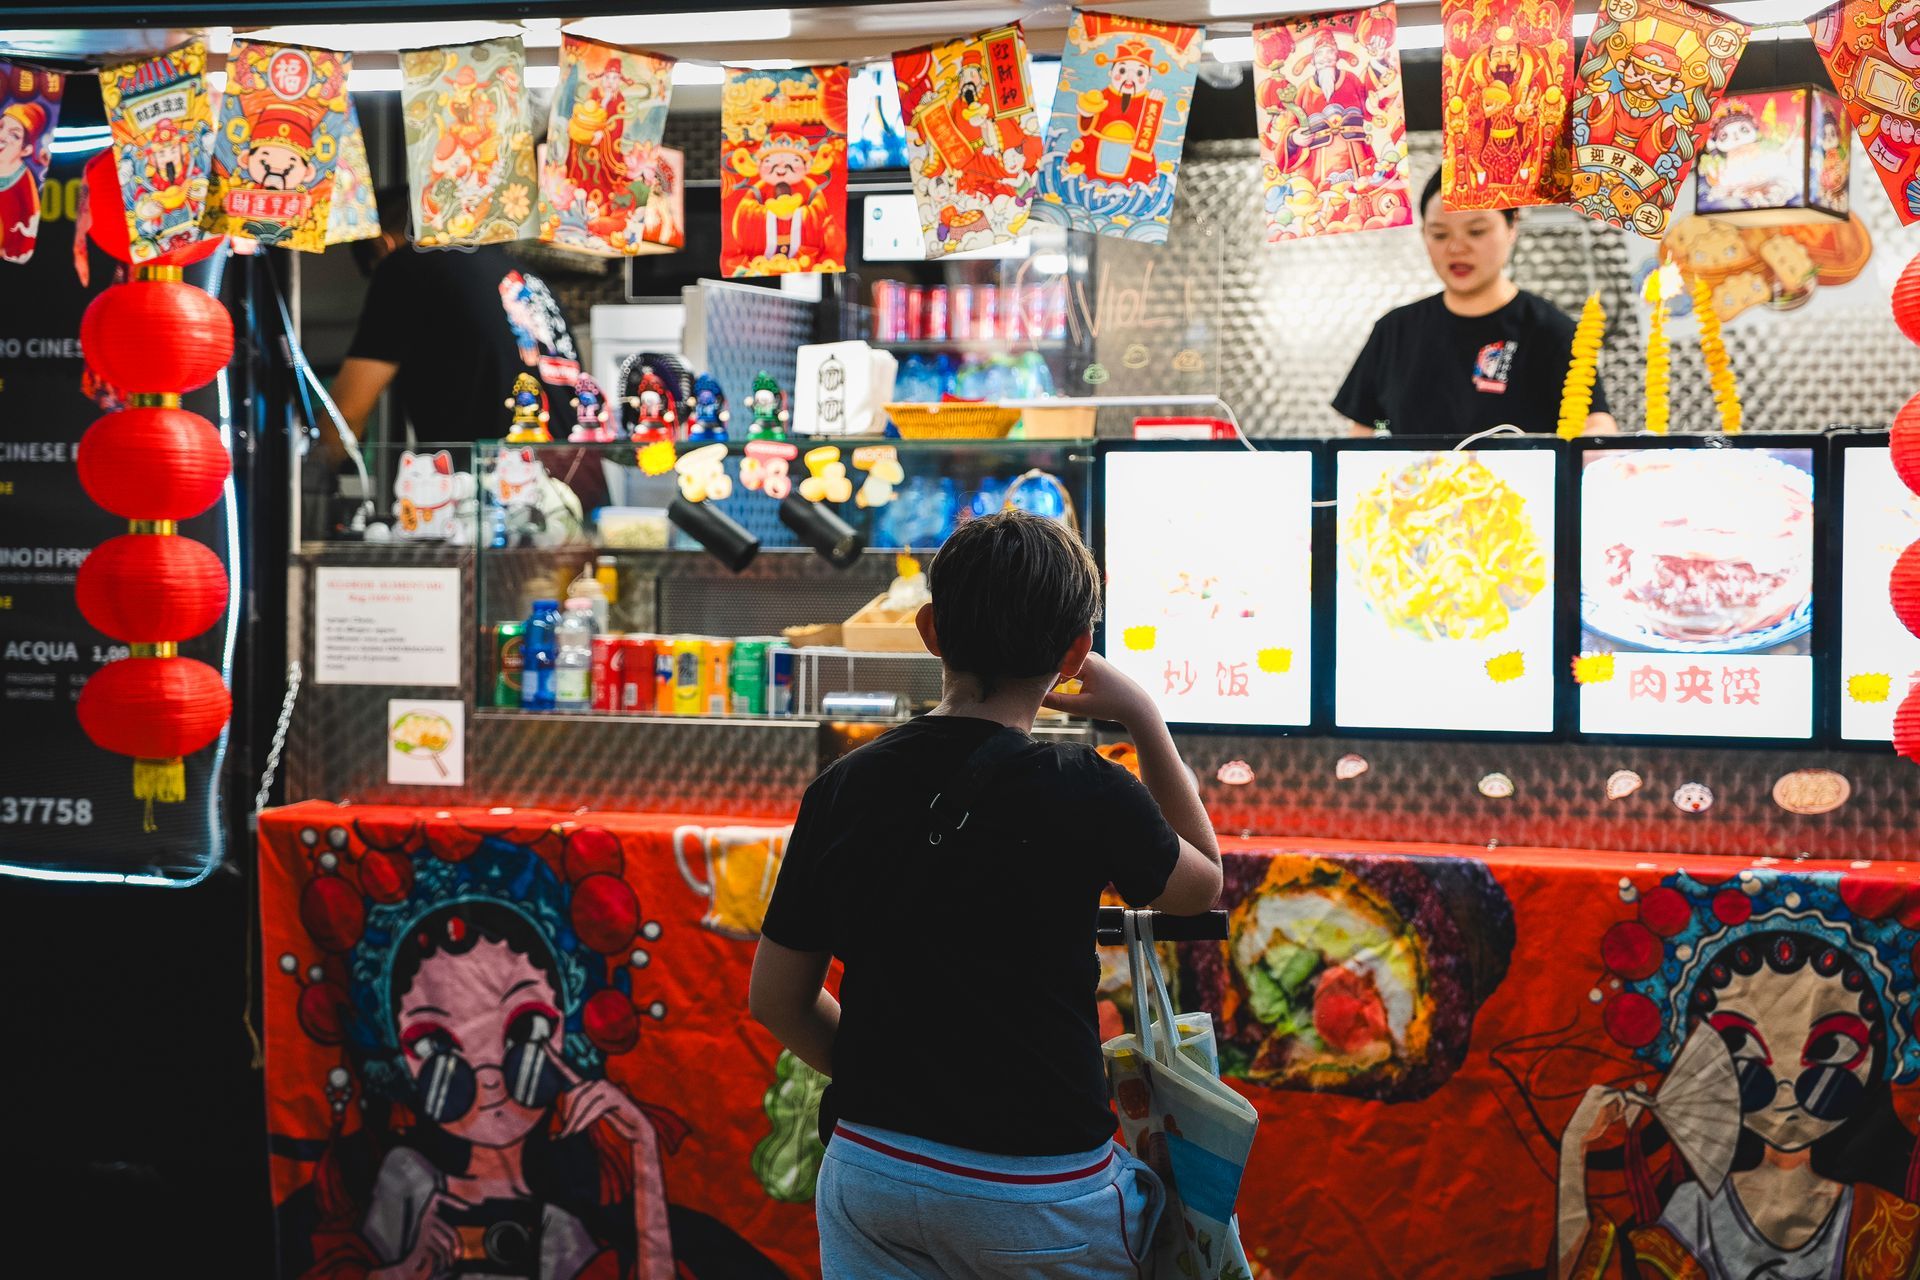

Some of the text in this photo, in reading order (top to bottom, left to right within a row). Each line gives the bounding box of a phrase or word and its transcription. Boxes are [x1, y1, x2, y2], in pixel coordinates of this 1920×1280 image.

[1708, 34, 1736, 52] 财
[275, 58, 302, 93] 福
[1590, 147, 1645, 178] 迎财神
[1635, 210, 1659, 228] 宝
[5, 640, 79, 665] ACQUA
[1163, 659, 1249, 697] 炒饭
[1629, 664, 1761, 706] 肉夹馍
